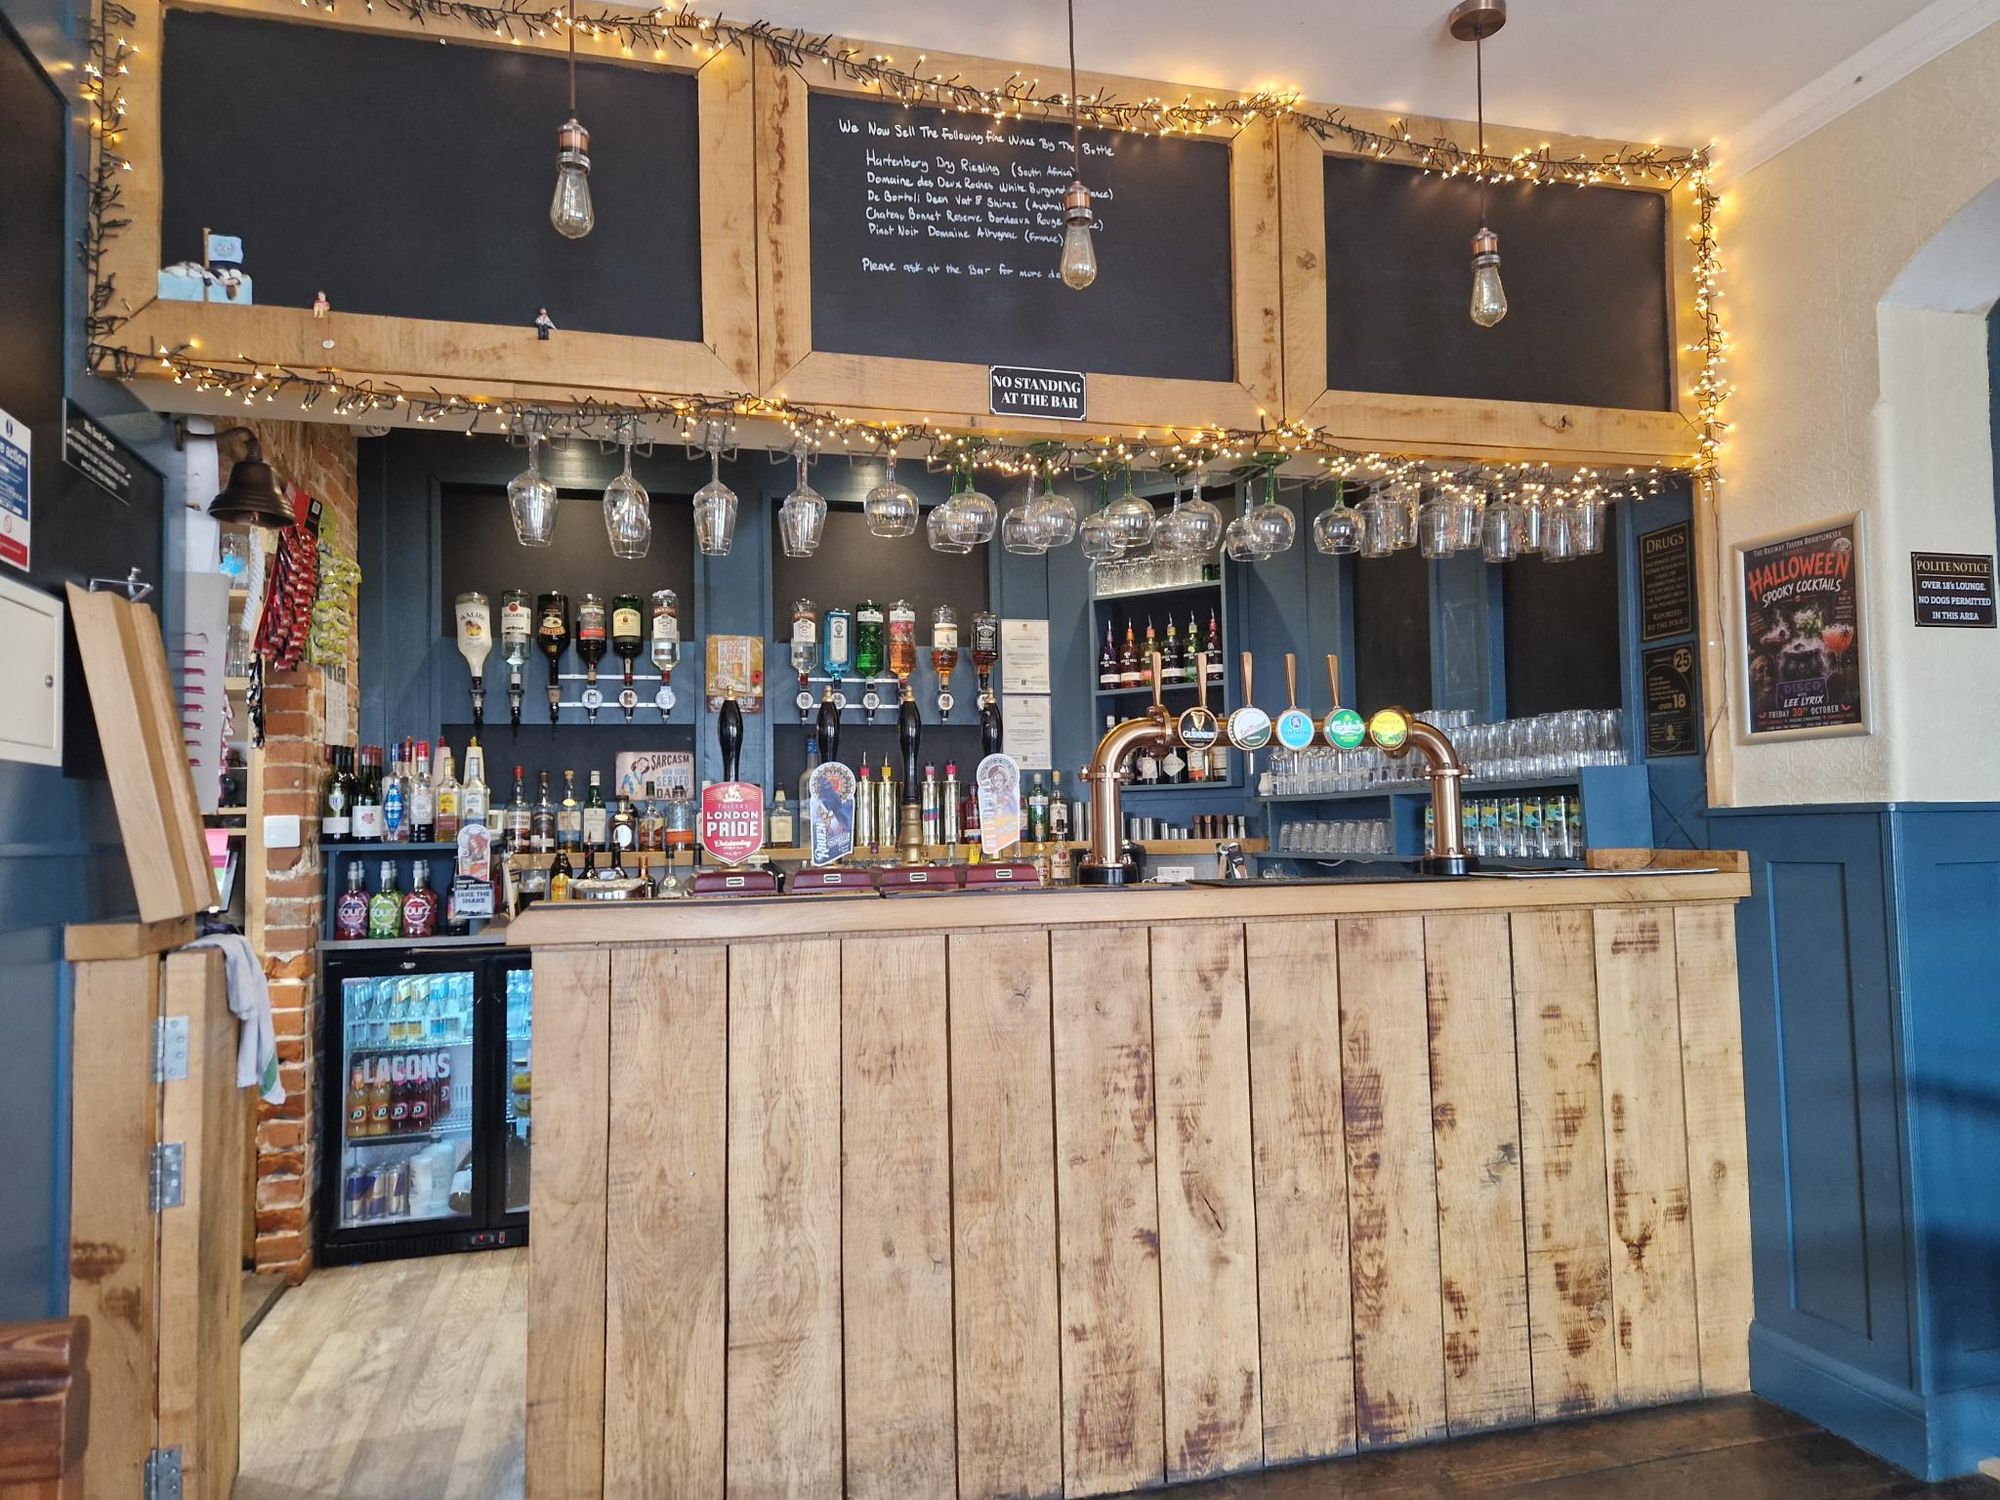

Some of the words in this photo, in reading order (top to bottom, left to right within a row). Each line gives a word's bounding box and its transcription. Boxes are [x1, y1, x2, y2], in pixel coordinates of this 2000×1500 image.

[838, 118, 860, 134] We
[868, 121, 890, 136] Now
[894, 124, 915, 138] Sell
[919, 125, 938, 138] The
[941, 127, 983, 144] Following
[985, 130, 1004, 143] Fine
[1008, 134, 1035, 146] Wines
[1039, 138, 1055, 151] By
[1082, 142, 1115, 157] Bottle
[866, 148, 929, 173] Hartenberg
[936, 156, 955, 175] Dry
[960, 158, 1000, 175] Riesling
[1011, 161, 1042, 178] (South
[866, 171, 914, 187] Domaine
[917, 175, 934, 187] des
[999, 181, 1027, 193] White
[867, 189, 880, 202] De
[884, 190, 920, 204] Bortoli
[955, 194, 972, 206] Vat
[975, 195, 982, 206] 8
[987, 197, 1018, 210] Shiraz
[1037, 213, 1063, 228] Rouge
[868, 222, 895, 236] Pinot
[898, 225, 919, 237] Noir
[928, 225, 971, 239] Domaine
[862, 257, 896, 273] Please
[903, 262, 923, 274] ask
[927, 263, 940, 274] at
[946, 263, 962, 274] the
[968, 264, 991, 276] Bar
[999, 263, 1013, 274] for
[1019, 269, 1043, 278] more
[993, 375, 1012, 388] NO
[1014, 377, 1081, 394] STANDING
[1001, 392, 1019, 404] AT
[1021, 393, 1049, 407] THE
[1051, 396, 1079, 409] BAR
[1646, 532, 1684, 553] DRUGS
[1916, 560, 1952, 572] POLITE
[1952, 562, 1990, 573] NOTICE
[1748, 552, 1850, 602] HALLOWEEN
[1921, 580, 1941, 589] OVER
[1762, 583, 1795, 608] SPOOKY
[1796, 578, 1842, 592] COCKTAILS
[1918, 596, 1929, 604] NO
[1930, 596, 1950, 604] DOGS
[1951, 597, 1991, 606] PERMITTED
[1932, 611, 1941, 619] IN
[1942, 611, 1958, 620] THIS
[1959, 612, 1979, 620] AREA
[1675, 652, 1690, 668] 25
[1672, 693, 1686, 708] 18
[1784, 698, 1800, 708] LEE
[1801, 695, 1824, 705] LYRIX
[1768, 710, 1790, 719] FRIDAY
[1810, 704, 1839, 715] OCTOBER
[1182, 730, 1215, 739] GUINNESS
[651, 754, 689, 771] SARCASM
[656, 776, 689, 787] SERVED
[706, 811, 758, 820] LONDON
[707, 820, 758, 837] PRIDE
